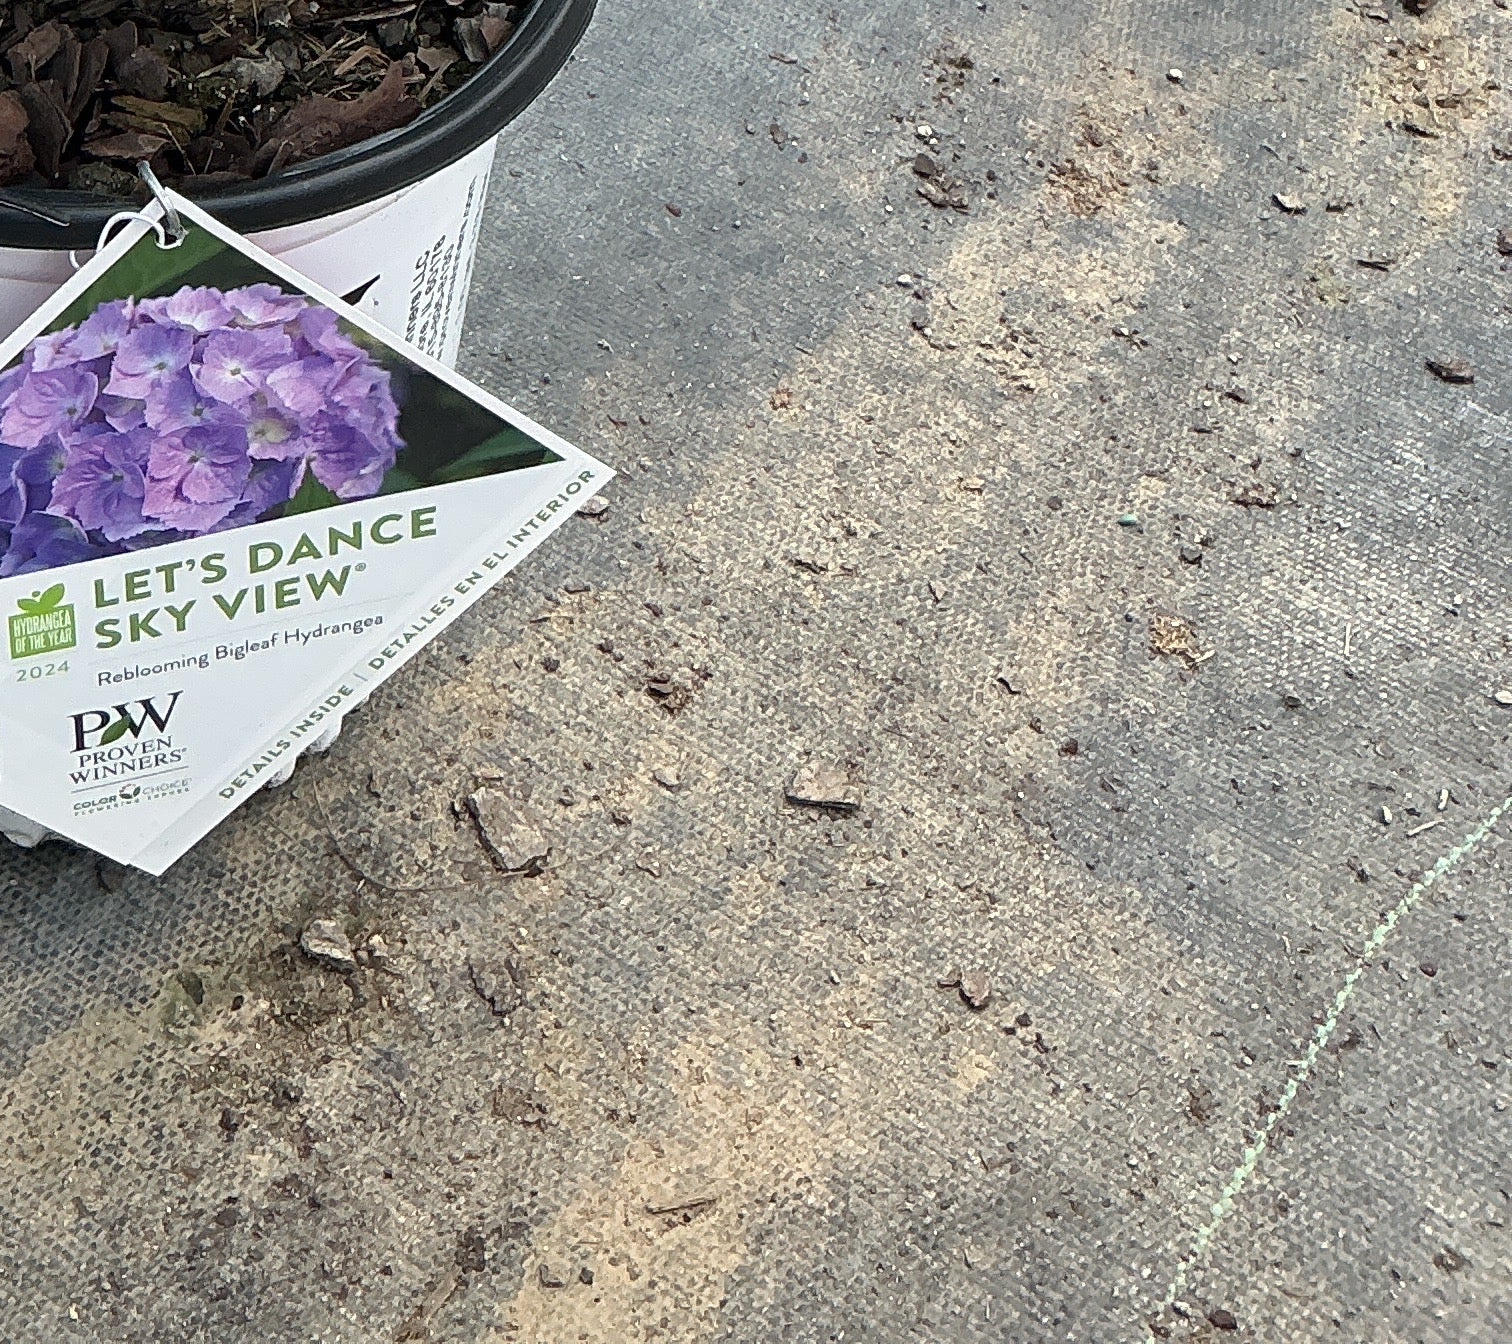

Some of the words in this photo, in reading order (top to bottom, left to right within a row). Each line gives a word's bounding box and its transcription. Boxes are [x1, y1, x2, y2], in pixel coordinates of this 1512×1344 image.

[93, 552, 228, 609] LET'S
[249, 505, 438, 574] DANCE
[13, 609, 72, 637] HYDRANGEA
[15, 636, 26, 653] OF
[29, 633, 47, 650] THE
[48, 627, 73, 647] YEAR
[94, 599, 197, 650] SKY
[219, 737, 292, 800] DETAILS
[291, 683, 354, 740] INSIDE
[368, 594, 456, 672] DETALLES
[456, 570, 484, 596] EN
[482, 550, 508, 573] EL
[509, 468, 596, 551] INTERIOR
[16, 660, 71, 682] 2024
[97, 652, 210, 687] Reblooming
[215, 631, 279, 662] Bigleaf
[285, 614, 385, 646] Hydrangea
[66, 689, 185, 754] PW
[78, 735, 173, 768] PROVEN
[73, 794, 118, 811] COLOR
